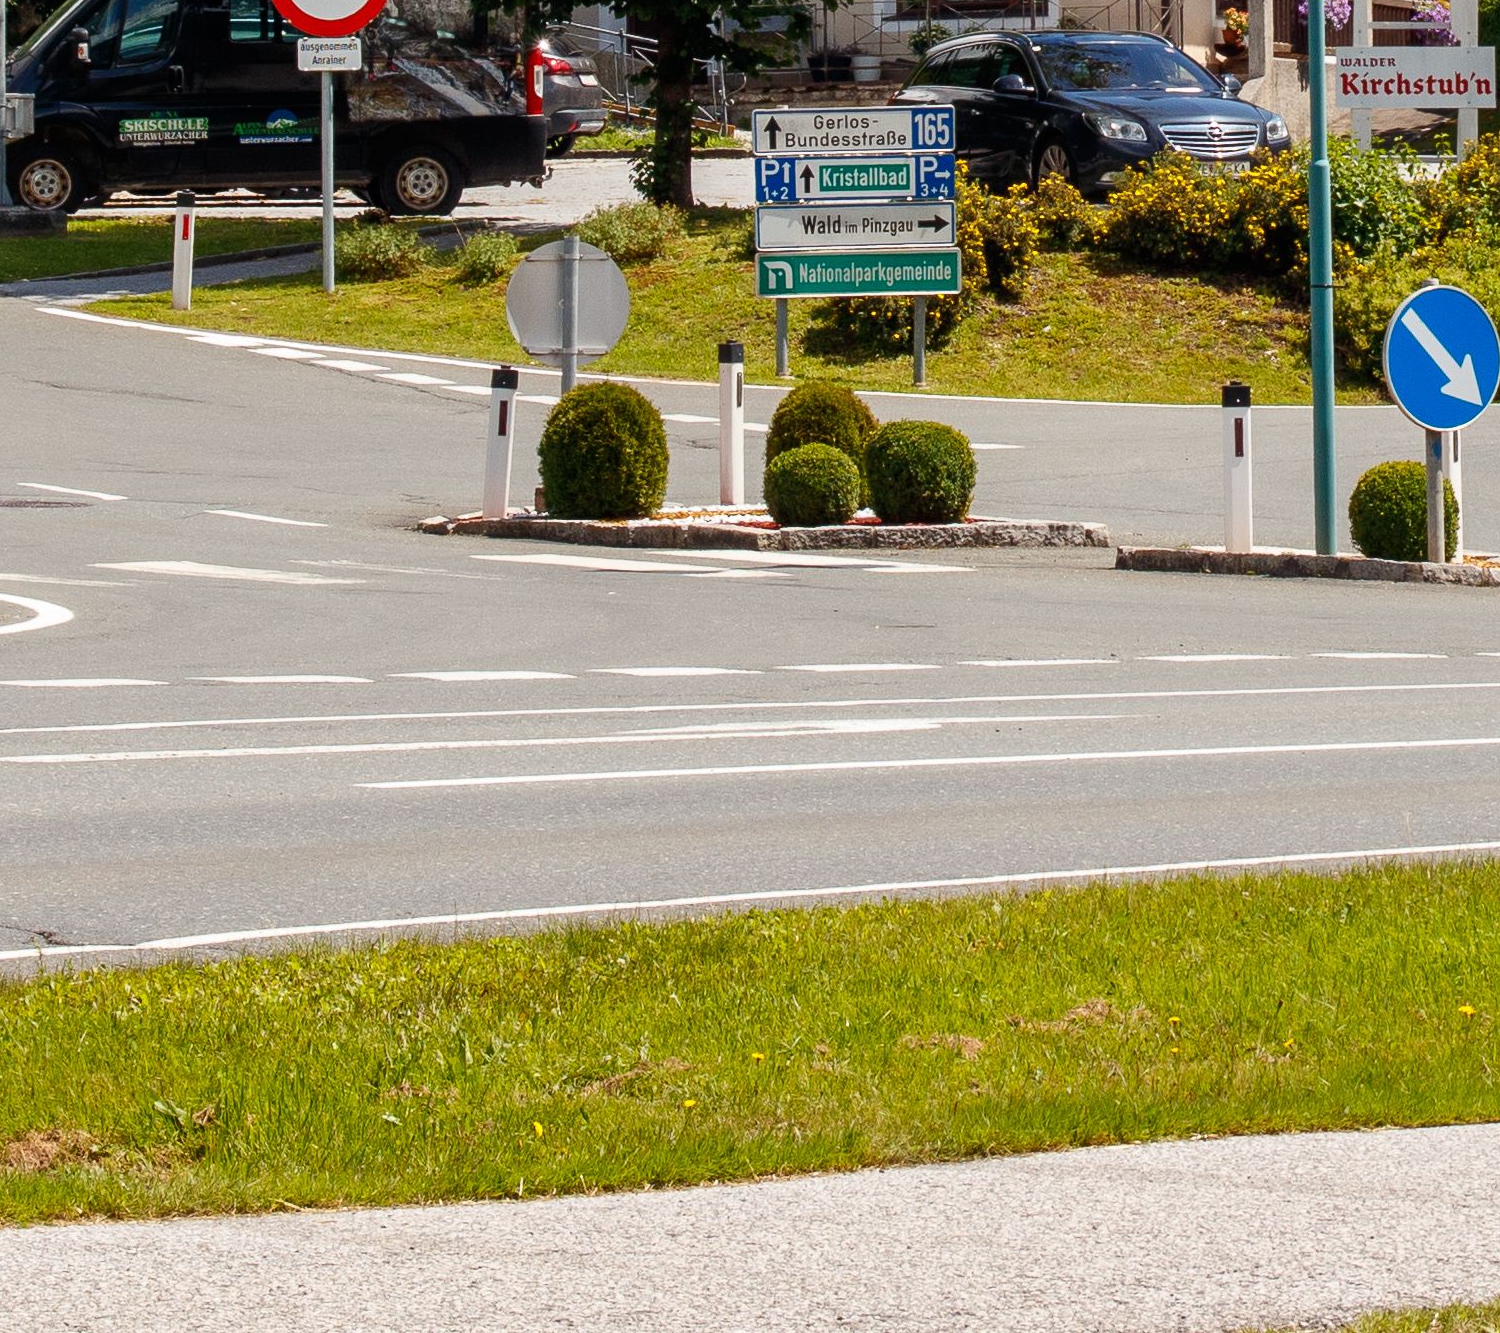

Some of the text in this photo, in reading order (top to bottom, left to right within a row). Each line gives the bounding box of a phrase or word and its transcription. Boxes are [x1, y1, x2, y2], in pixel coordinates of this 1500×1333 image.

[300, 43, 358, 53] ausgenommen
[312, 55, 347, 65] Anrainer
[1340, 57, 1397, 67] WALDER
[1340, 71, 1493, 96] Kirchstub'n
[124, 118, 205, 132] SKISCHULE
[813, 115, 879, 130] Gerlos-
[914, 113, 950, 146] 165
[119, 130, 209, 142] UNTERWURZACHER
[785, 131, 907, 148] Bundesstraße
[761, 160, 780, 186] P
[821, 166, 908, 188] Kristallbad
[919, 157, 938, 183] P
[763, 187, 789, 200] 1+2
[920, 183, 949, 197] 3+4
[802, 214, 913, 237] Wald im Pinzgau
[800, 259, 952, 287] Nationalparkgemeinde
